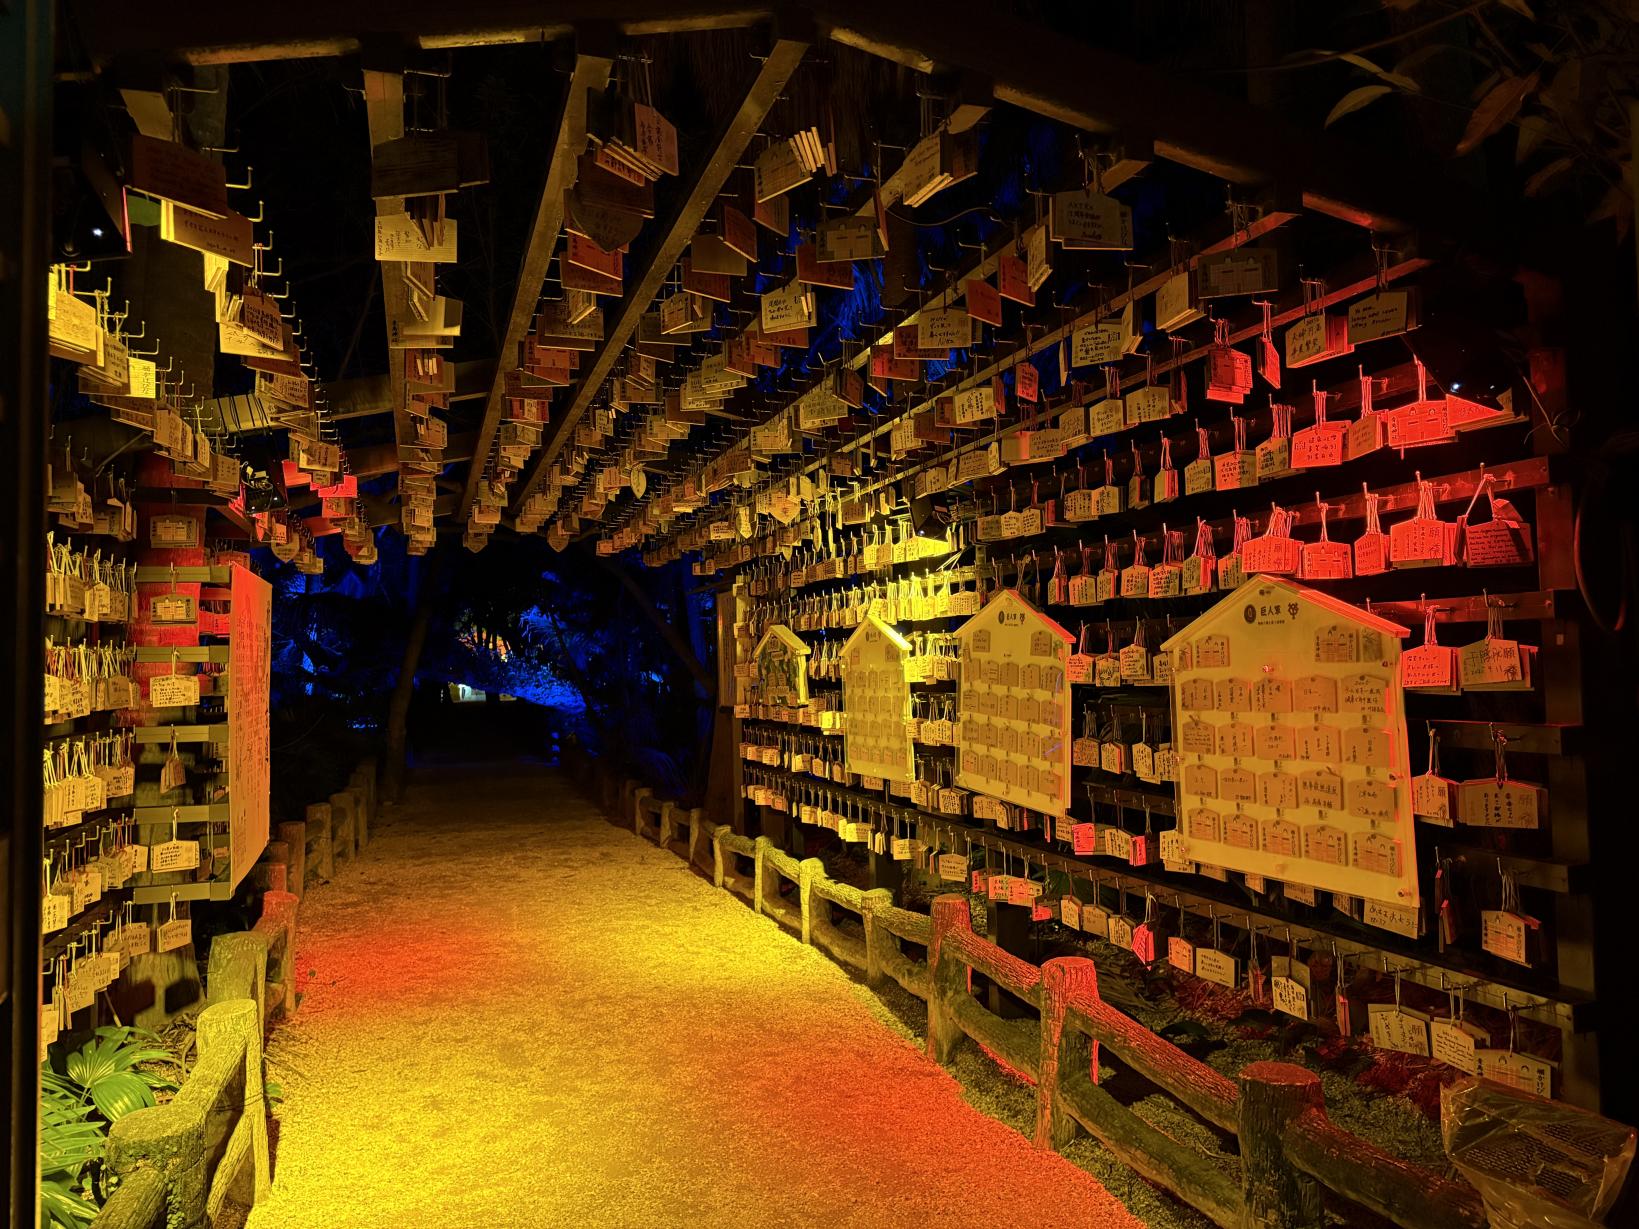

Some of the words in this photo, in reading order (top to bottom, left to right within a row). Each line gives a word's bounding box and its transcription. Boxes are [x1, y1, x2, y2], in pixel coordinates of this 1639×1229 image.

[1260, 605, 1281, 617] 巨人軍
[1536, 1069, 1545, 1094] 願かけび
